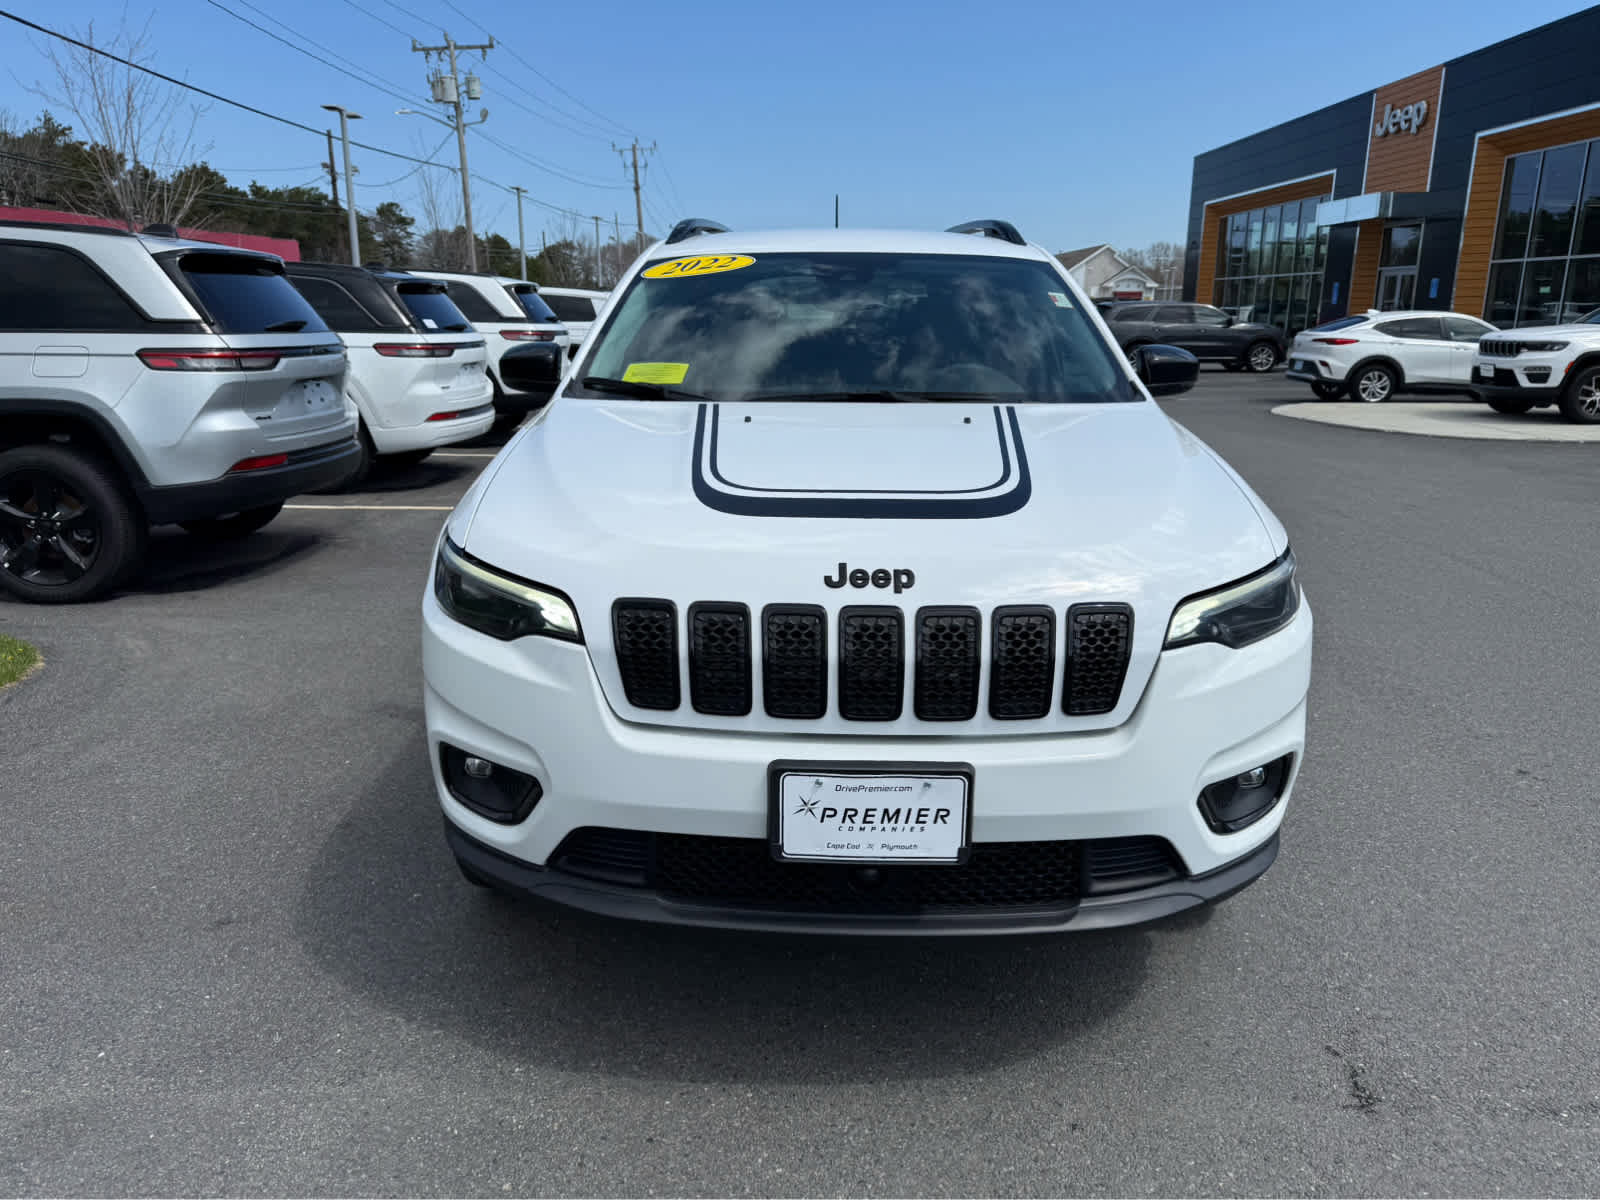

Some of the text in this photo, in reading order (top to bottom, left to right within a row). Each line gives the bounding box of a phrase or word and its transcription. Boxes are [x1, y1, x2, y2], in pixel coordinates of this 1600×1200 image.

[1375, 100, 1427, 136] Jeep
[662, 257, 737, 275] 2022
[823, 562, 915, 594] Jeep
[834, 784, 913, 793] DrivePremier.com
[819, 807, 951, 825] PREMIER
[838, 825, 926, 833] COMPANIES
[826, 841, 861, 851] Cape Cod
[881, 842, 918, 852] Plymouth
